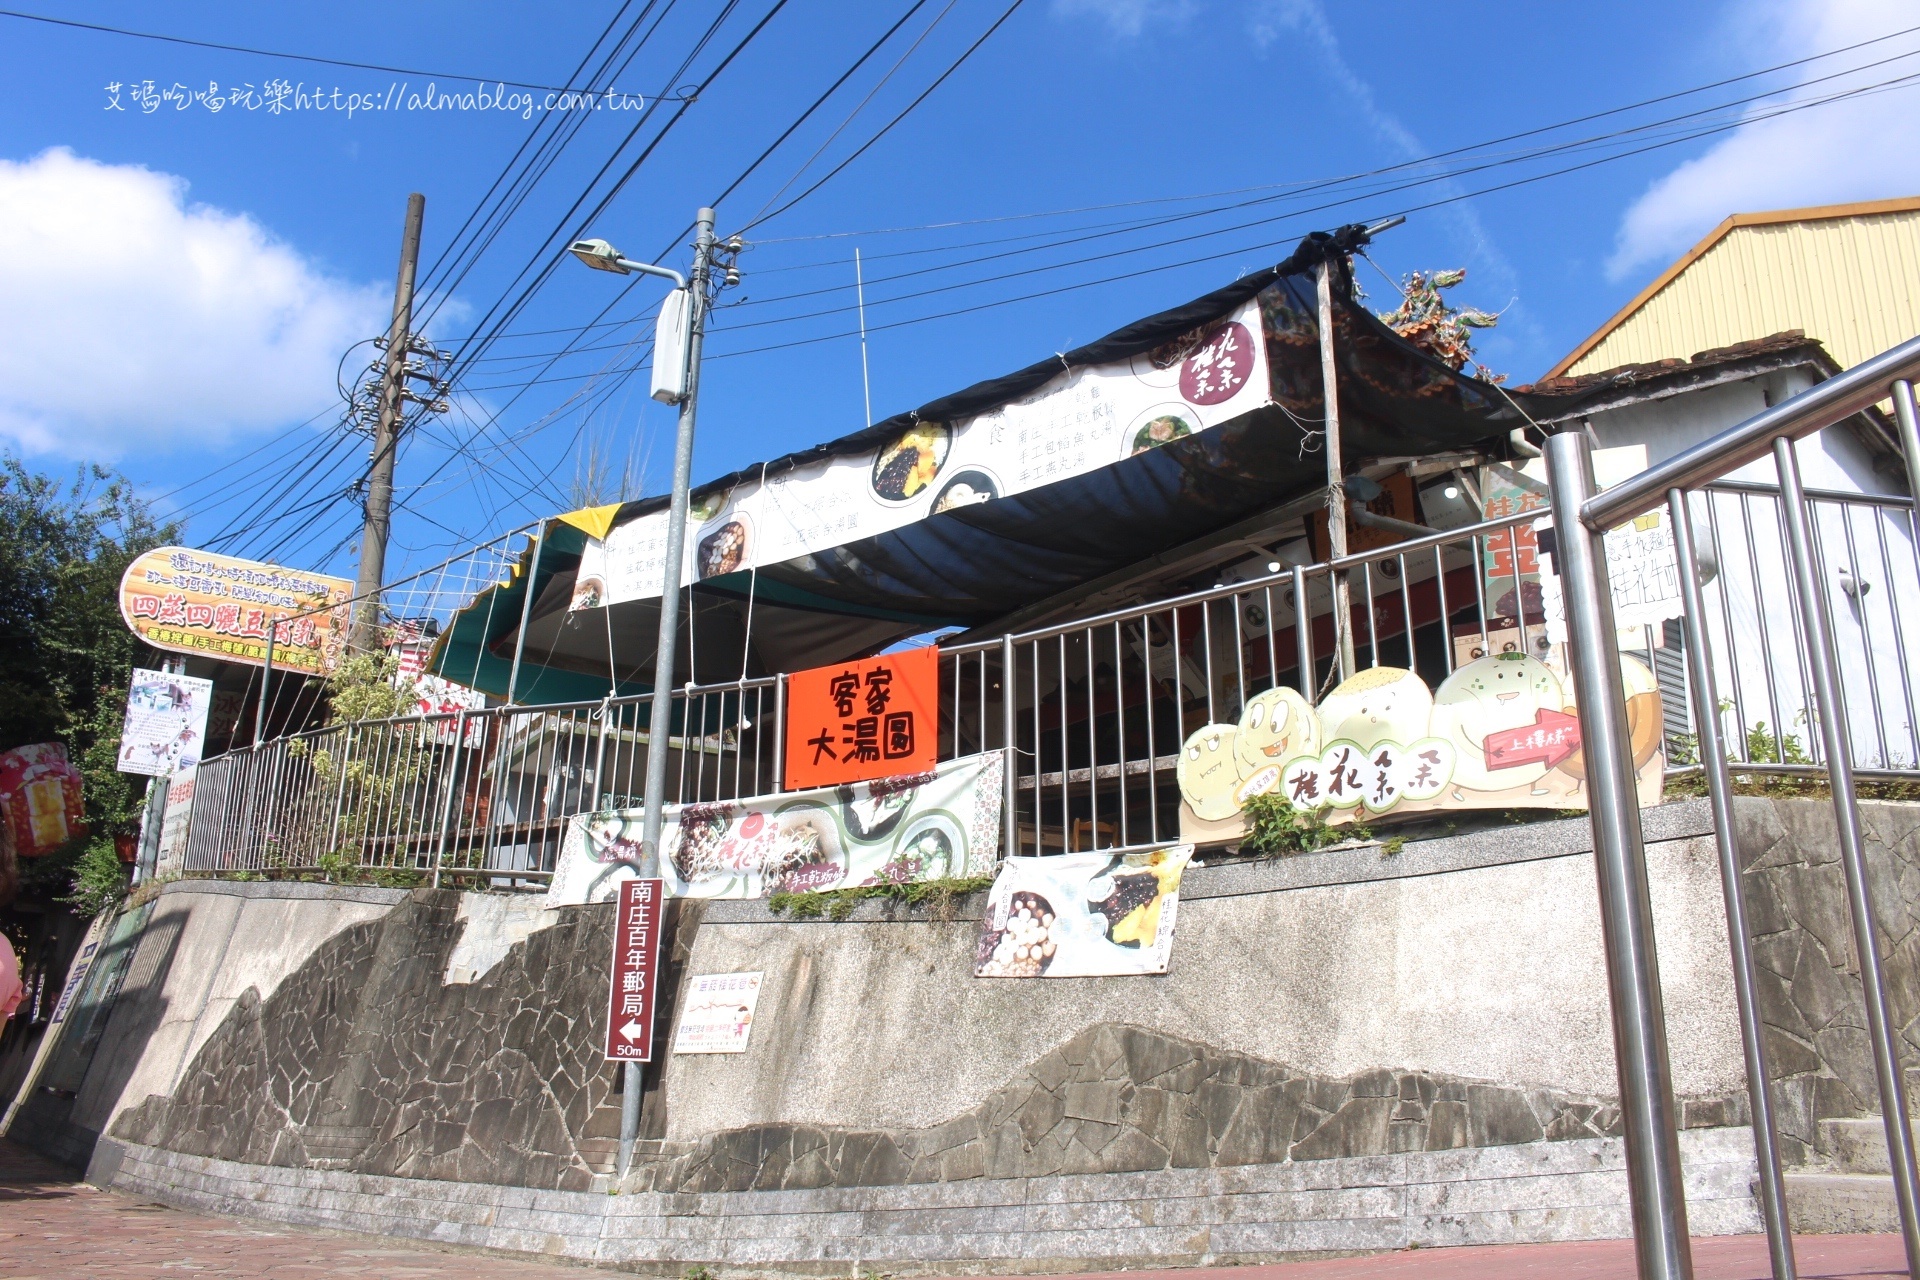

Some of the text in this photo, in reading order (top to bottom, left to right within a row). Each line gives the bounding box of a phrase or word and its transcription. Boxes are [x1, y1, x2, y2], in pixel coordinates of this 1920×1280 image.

[131, 593, 317, 648] 四蒸四曬豆腐乳
[829, 666, 894, 718] 客家
[807, 710, 916, 766] 大湯圓
[620, 881, 653, 1017] 南庄百年郵局
[1153, 898, 1173, 963] 桂花綜合冰
[616, 1045, 642, 1057] 50m
